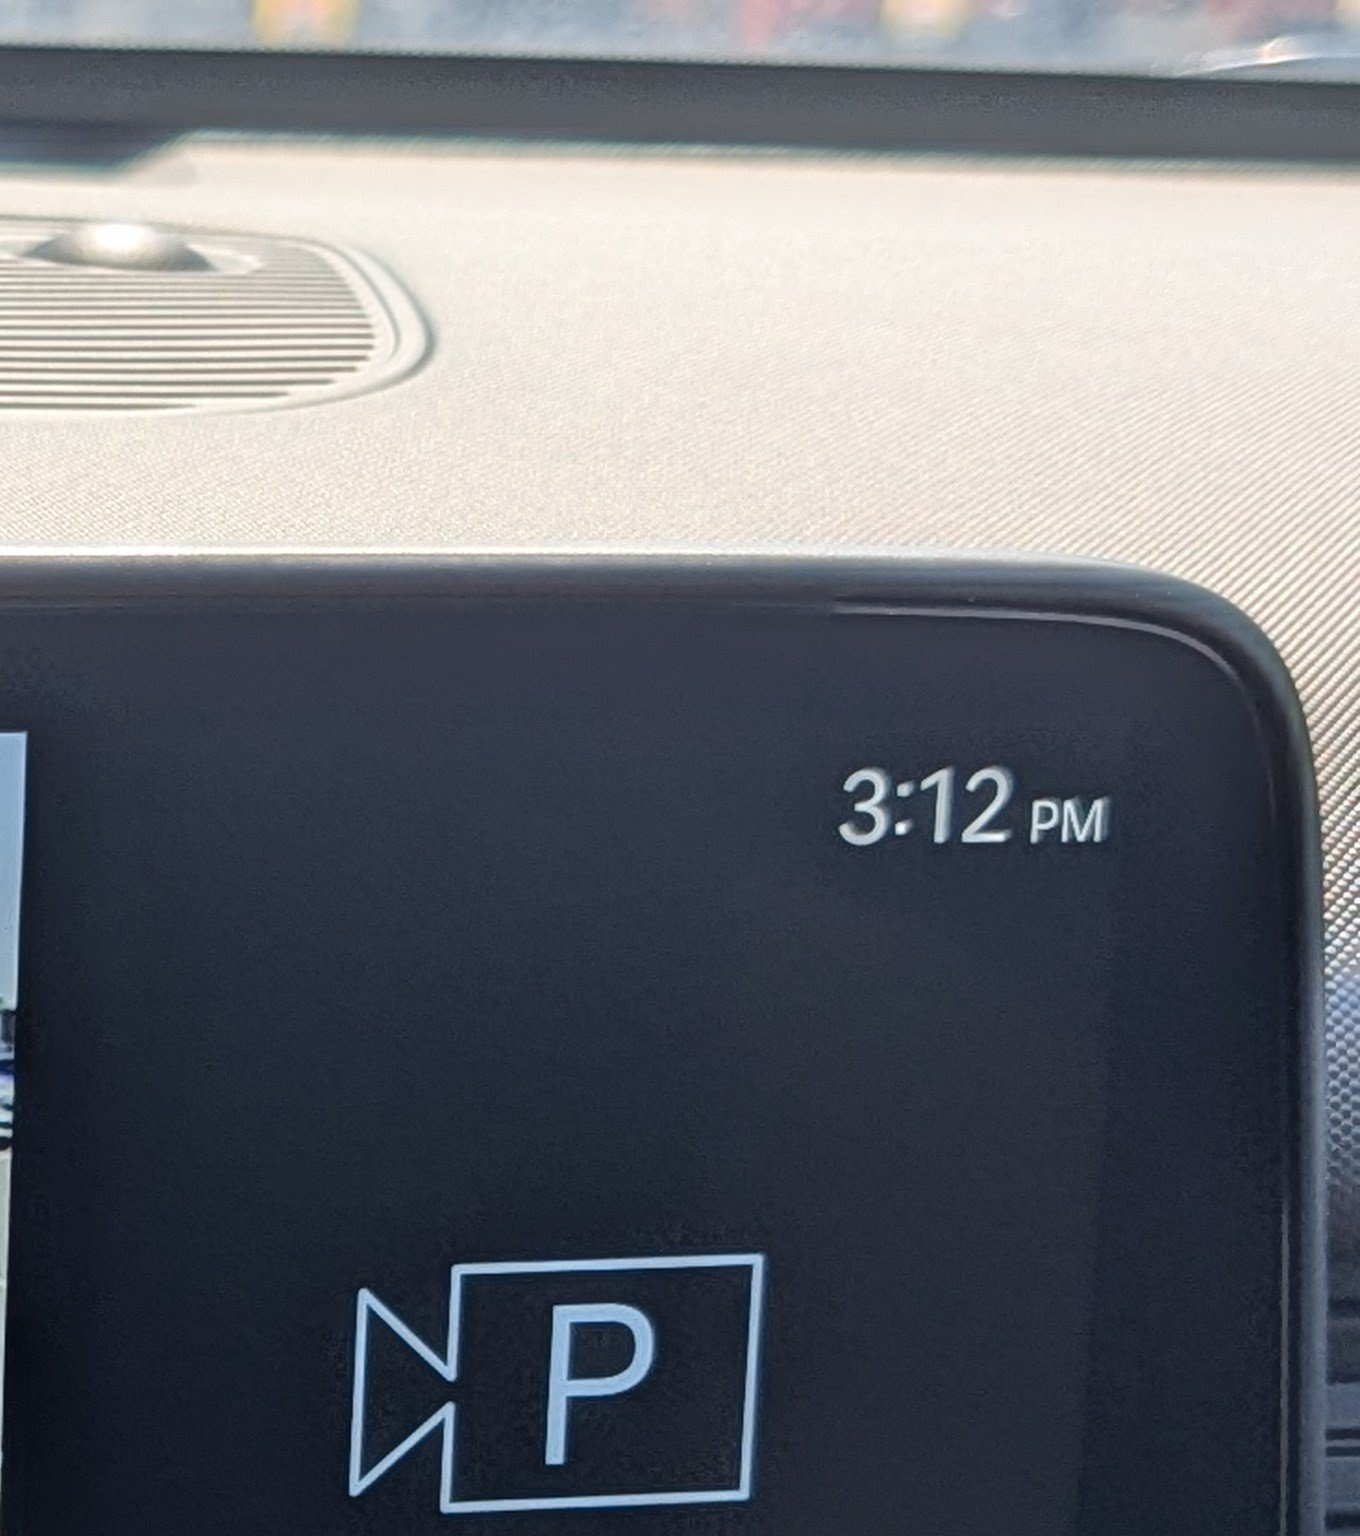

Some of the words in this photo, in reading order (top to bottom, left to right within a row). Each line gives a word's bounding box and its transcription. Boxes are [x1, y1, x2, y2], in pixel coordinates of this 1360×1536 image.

[838, 766, 1015, 847] 3:12
[1030, 796, 1110, 844] PM
[544, 1303, 656, 1466] P
